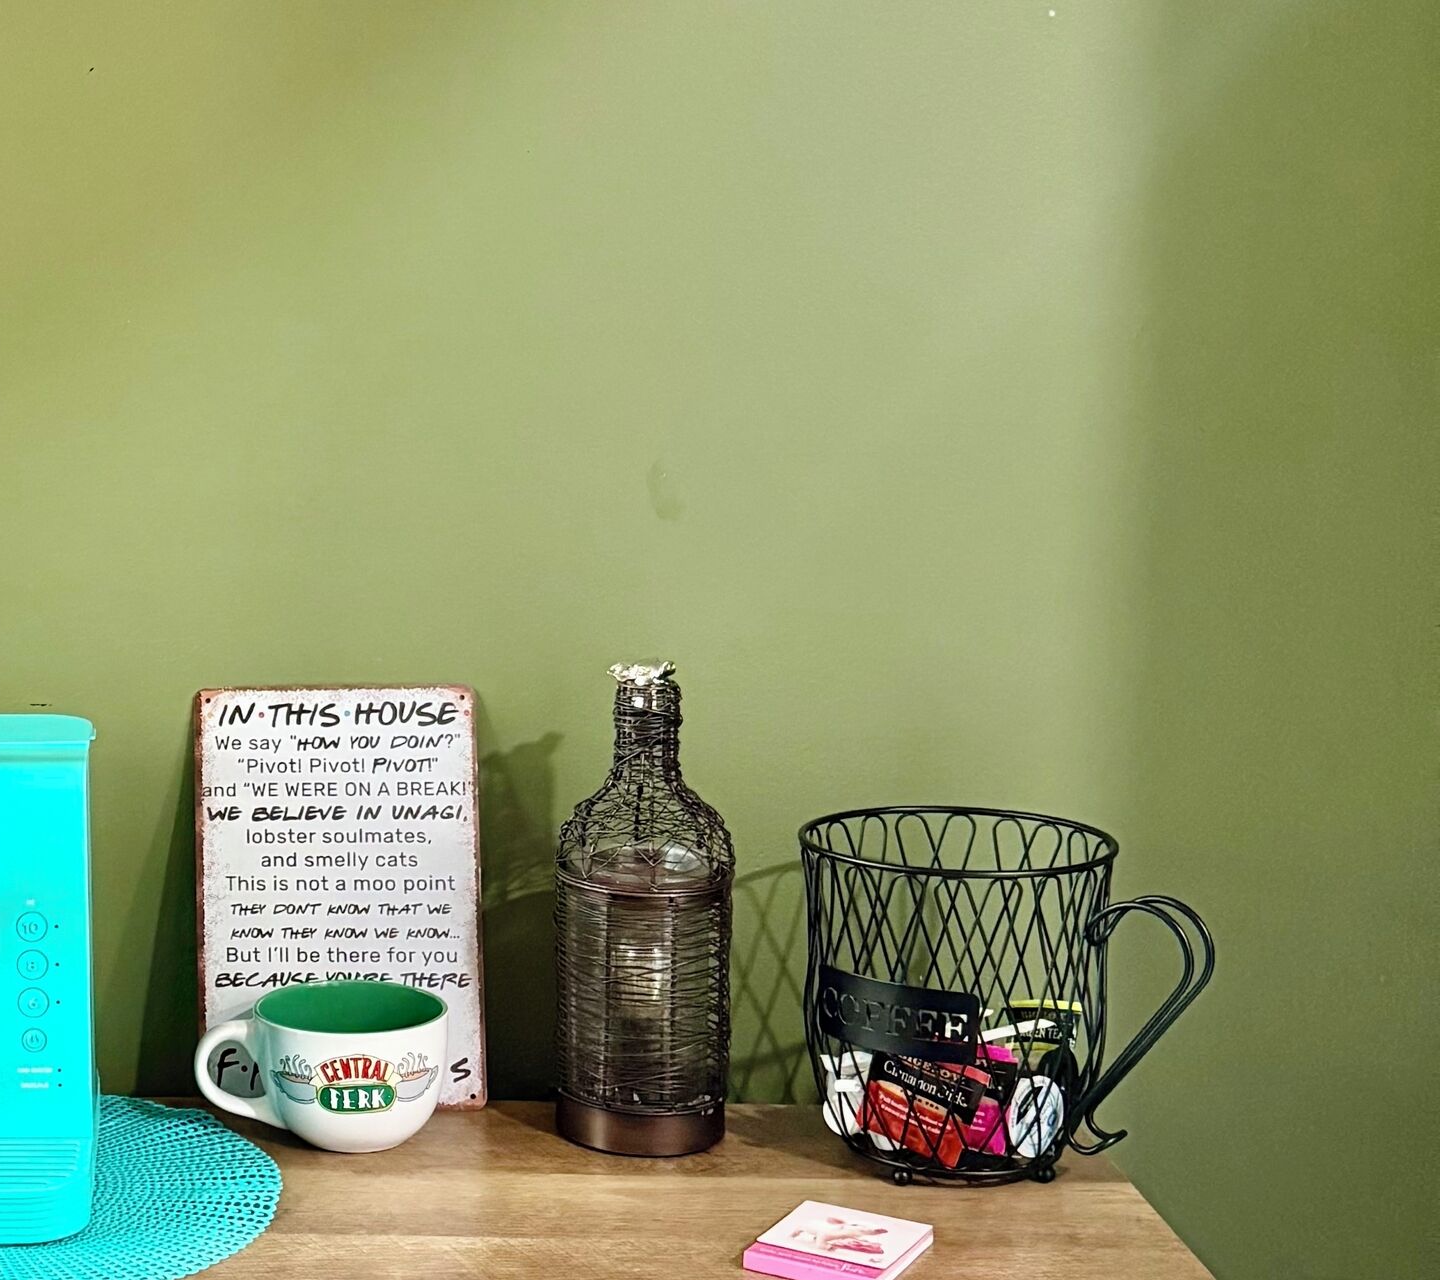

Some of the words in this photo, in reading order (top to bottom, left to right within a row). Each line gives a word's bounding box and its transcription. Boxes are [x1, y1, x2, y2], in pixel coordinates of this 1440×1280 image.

[218, 702, 256, 727] IN
[267, 702, 341, 728] THIS
[354, 701, 460, 727] HOUSE
[215, 736, 242, 750] We
[248, 738, 282, 754] say
[350, 735, 381, 749] YOU
[310, 758, 365, 773] Pivot!
[202, 782, 237, 797] and
[285, 782, 338, 797] WERE
[345, 782, 371, 797] ON
[377, 782, 391, 797] A
[206, 806, 242, 821] WE
[251, 805, 347, 822] BELIEVE
[356, 805, 382, 820] IN
[246, 829, 316, 844] lobster
[322, 829, 432, 846] soulmates,
[261, 852, 297, 868] and
[304, 852, 368, 871] smelly
[375, 854, 418, 868] cats
[225, 876, 266, 891] This
[273, 876, 289, 891] is
[296, 877, 329, 891] not
[335, 880, 346, 891] a
[354, 880, 396, 891] moo
[404, 876, 456, 894] point
[230, 903, 266, 916] THEY
[327, 904, 371, 916] KNOW
[378, 903, 424, 915] THAT
[427, 904, 453, 915] WE
[22, 922, 39, 935] 10
[230, 927, 274, 940] KNOW
[281, 927, 318, 940] THEY
[324, 927, 368, 940] KNOW
[374, 928, 399, 939] WE
[226, 947, 261, 963] But
[268, 947, 289, 963] I'll
[297, 947, 320, 963] be
[327, 947, 381, 963] there
[387, 947, 416, 963] for
[421, 950, 458, 966] you
[215, 972, 320, 988] BECAUSE
[399, 972, 472, 990] THERE
[823, 986, 969, 1045] COFFEE
[320, 1057, 390, 1083] CENTRAL
[328, 1088, 387, 1110] PERK
